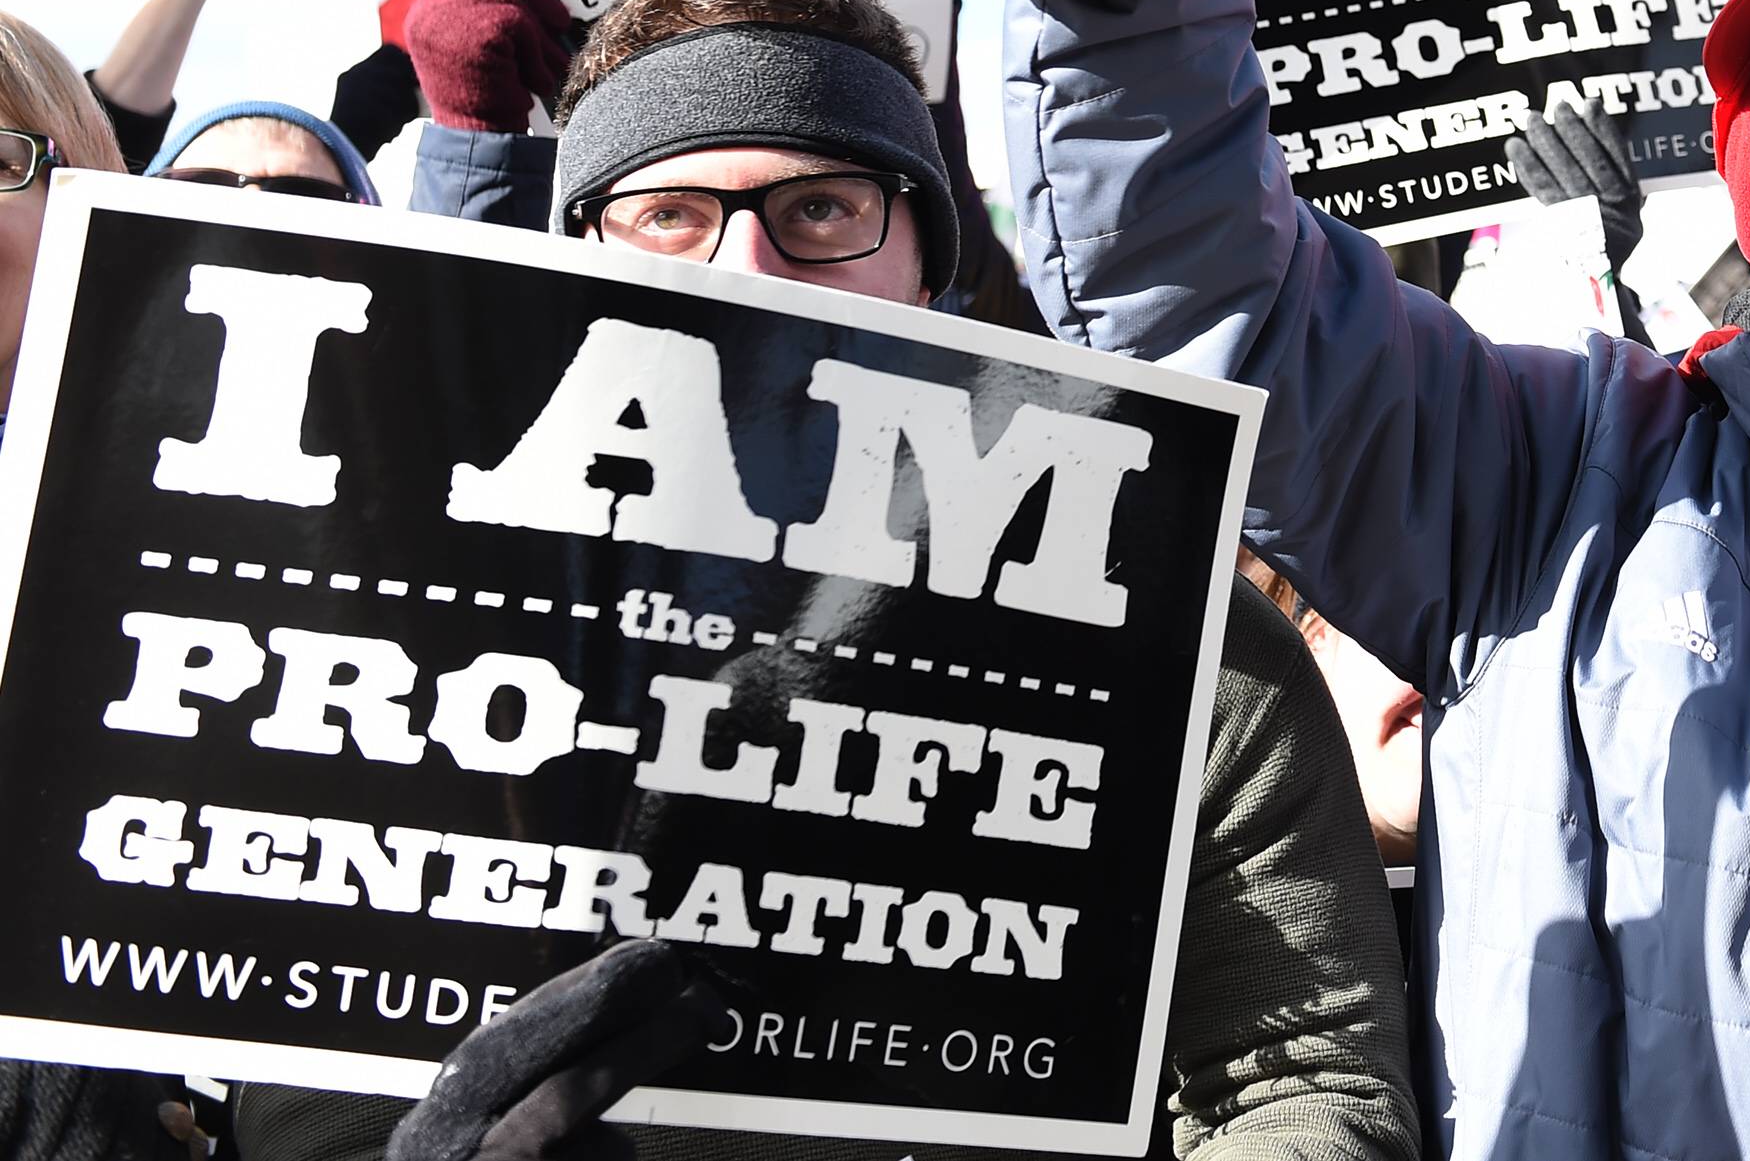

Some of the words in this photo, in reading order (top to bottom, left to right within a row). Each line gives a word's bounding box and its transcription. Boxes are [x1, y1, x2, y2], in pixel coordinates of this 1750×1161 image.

[150, 263, 376, 509] I
[446, 317, 1156, 628] AM
[617, 586, 736, 652] the
[102, 611, 1105, 851] PRO-LIFE
[79, 793, 1079, 981] GENERATION
